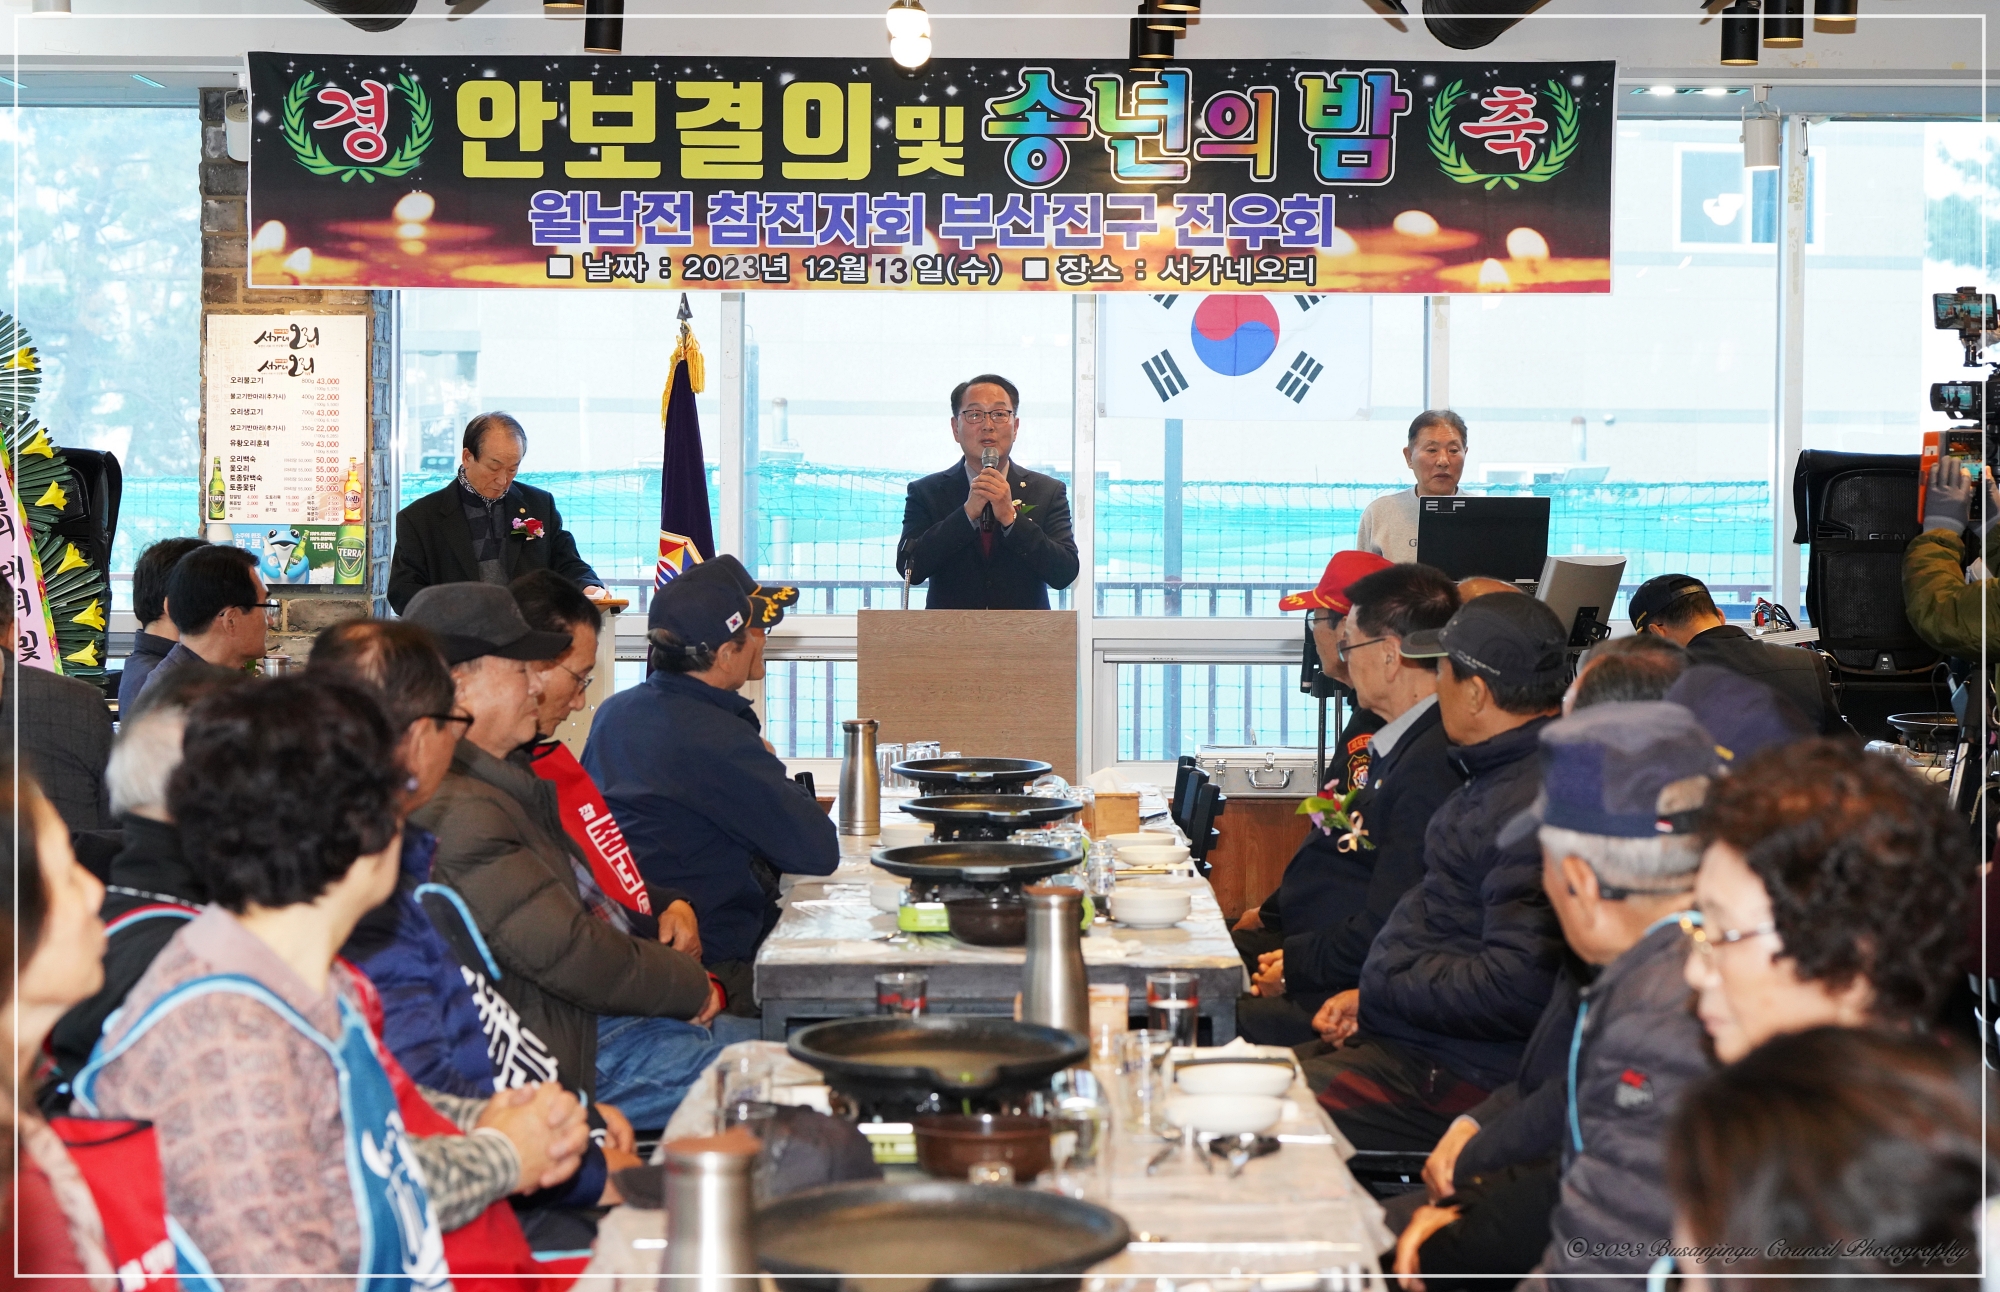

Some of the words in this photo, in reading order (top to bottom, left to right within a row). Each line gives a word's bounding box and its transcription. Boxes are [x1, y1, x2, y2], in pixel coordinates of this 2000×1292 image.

[313, 79, 390, 164] 경
[456, 79, 873, 181] 안보결의
[895, 104, 966, 178] 및
[981, 67, 1279, 188] 송년의
[1296, 67, 1411, 187] 밤
[1458, 85, 1548, 172] 축
[528, 189, 693, 247] 월남전
[707, 190, 925, 249] 참전자회
[939, 192, 1159, 251] 부산진구
[1174, 193, 1337, 250] 전우회
[582, 253, 650, 284] 날짜
[683, 253, 791, 284] 2023년
[803, 252, 870, 283] 12월
[1056, 254, 1124, 284] 장소
[1158, 254, 1319, 286] 서가네오리
[312, 542, 334, 550] TERRA
[338, 547, 362, 558] TERRA
